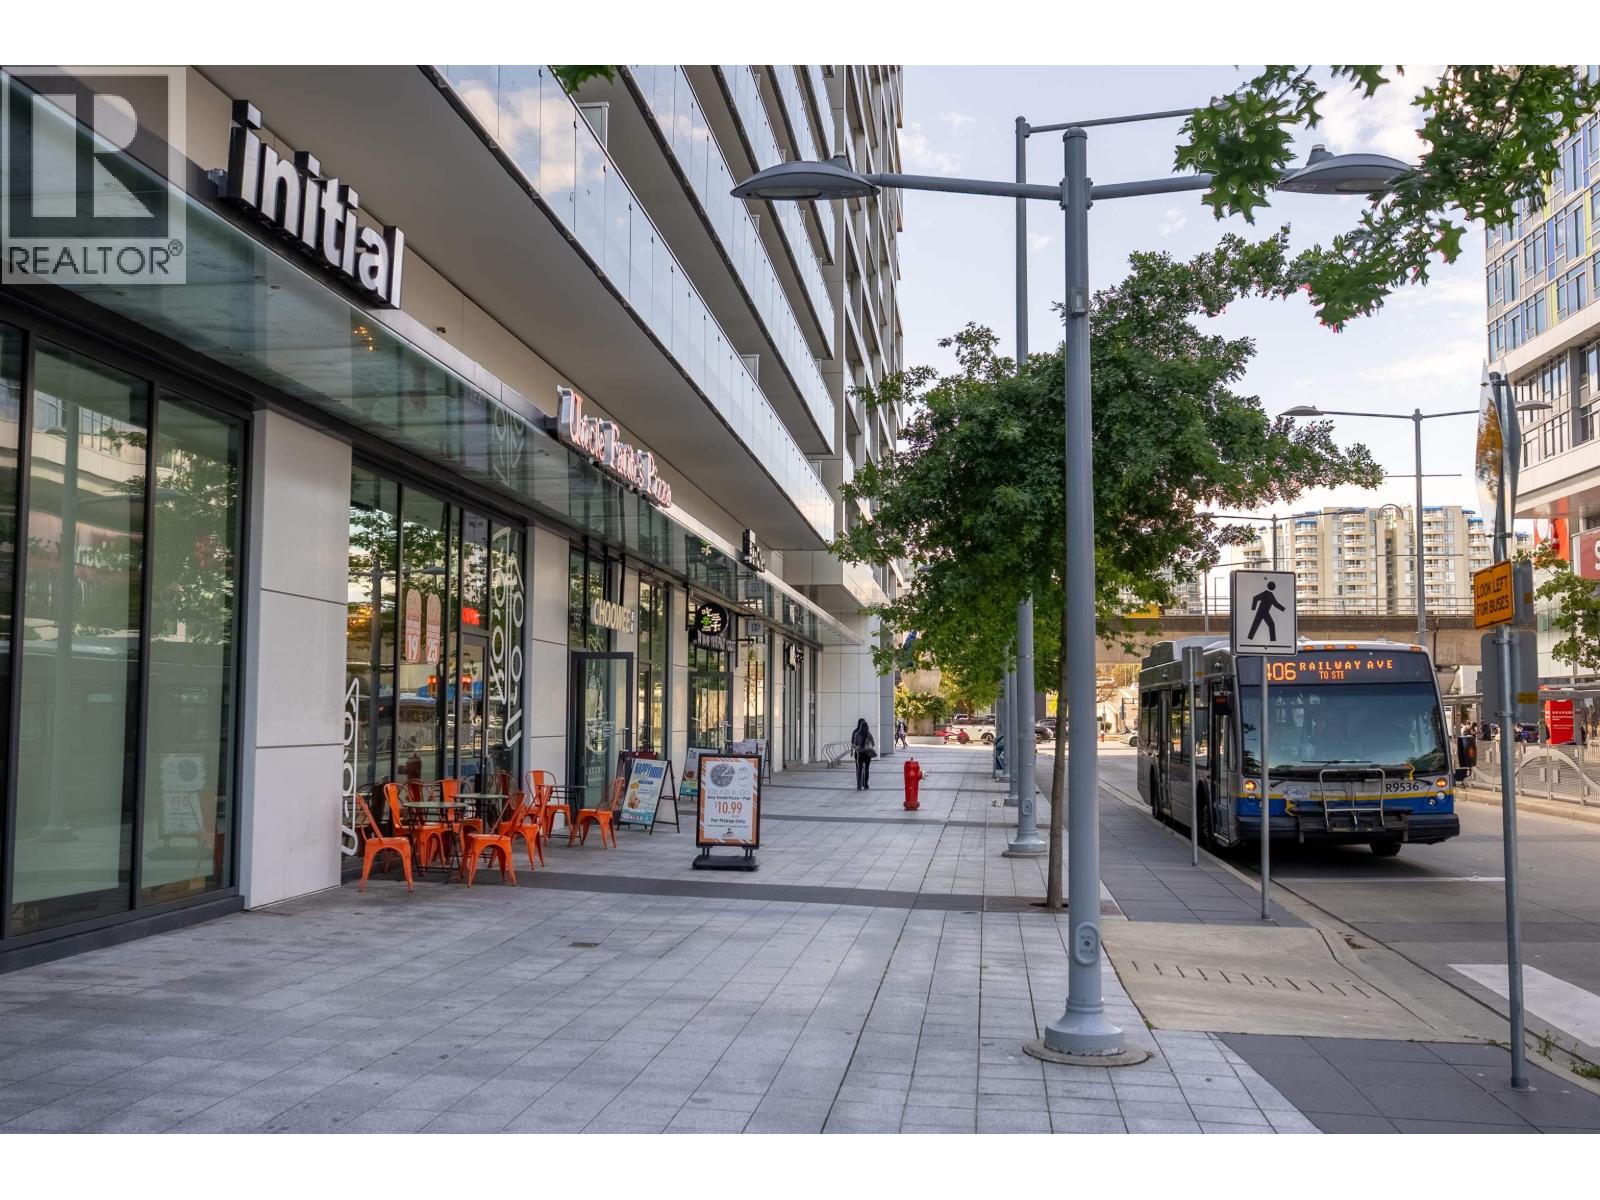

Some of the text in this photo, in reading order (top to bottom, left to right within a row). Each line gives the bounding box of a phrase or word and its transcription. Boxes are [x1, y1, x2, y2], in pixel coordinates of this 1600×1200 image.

[229, 99, 405, 310] initial
[1476, 575, 1508, 599] LOOK LEFT
[1476, 594, 1509, 617] FOR BUSES
[1299, 660, 1361, 671] RAILWAY
[1366, 659, 1393, 669] AVE
[1319, 670, 1329, 680] TO
[1385, 782, 1420, 793] R9536
[714, 801, 743, 815] $10.99
